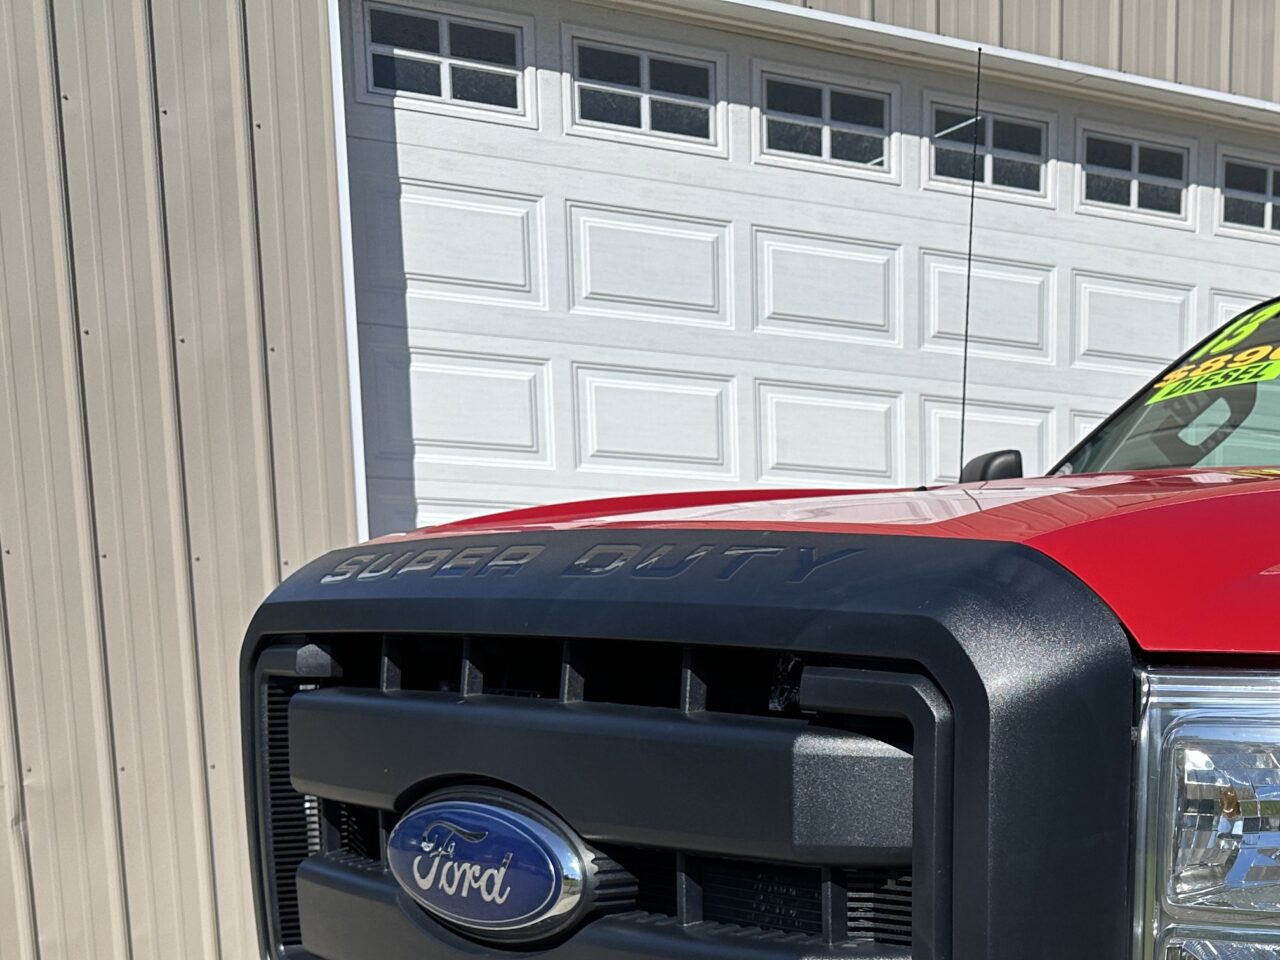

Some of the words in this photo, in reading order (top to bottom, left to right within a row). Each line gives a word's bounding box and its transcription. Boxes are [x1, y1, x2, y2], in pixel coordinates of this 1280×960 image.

[1161, 362, 1275, 398] DIESEL
[320, 545, 546, 584] SUPER
[560, 543, 864, 584] DUTY
[413, 820, 513, 904] Ford
